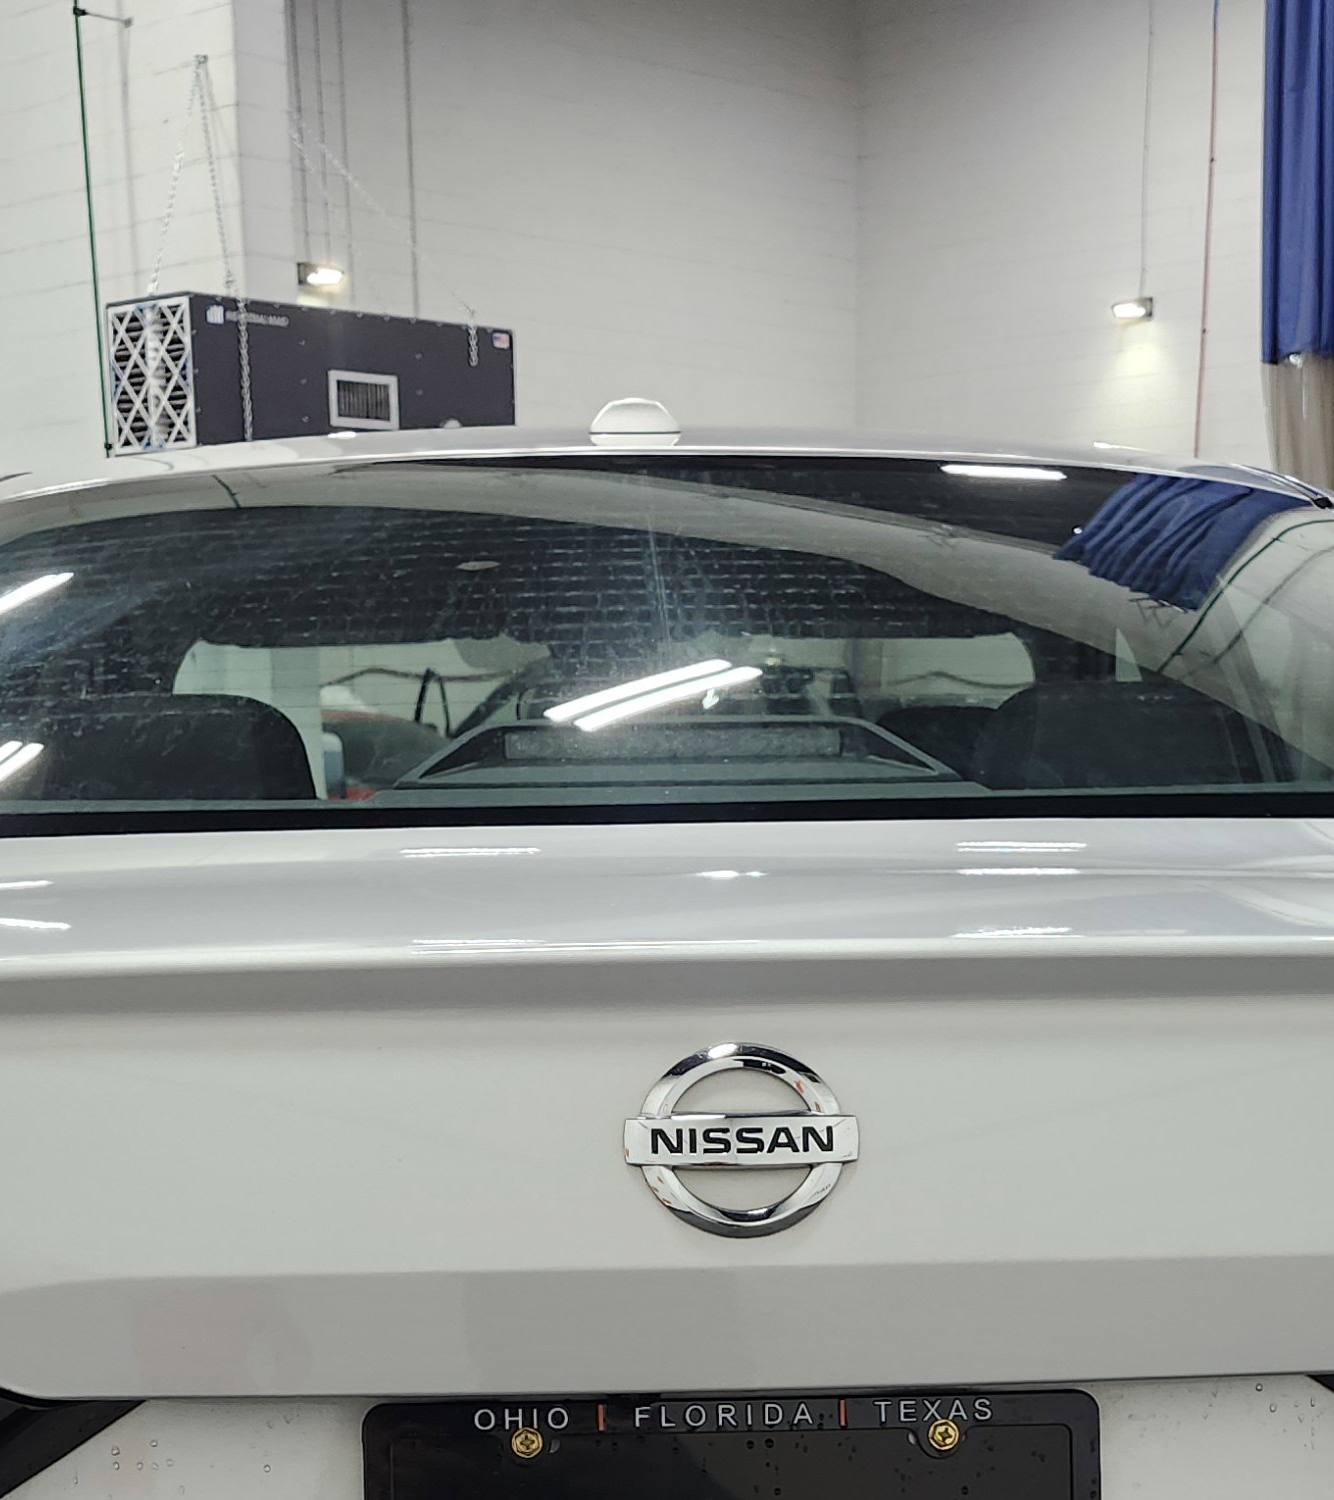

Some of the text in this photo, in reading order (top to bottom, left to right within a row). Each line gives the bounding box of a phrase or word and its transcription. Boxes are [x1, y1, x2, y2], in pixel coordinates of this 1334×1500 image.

[650, 1125, 835, 1155] NISSAN
[474, 1397, 994, 1432] OHIO FLORIDA TEXAS
